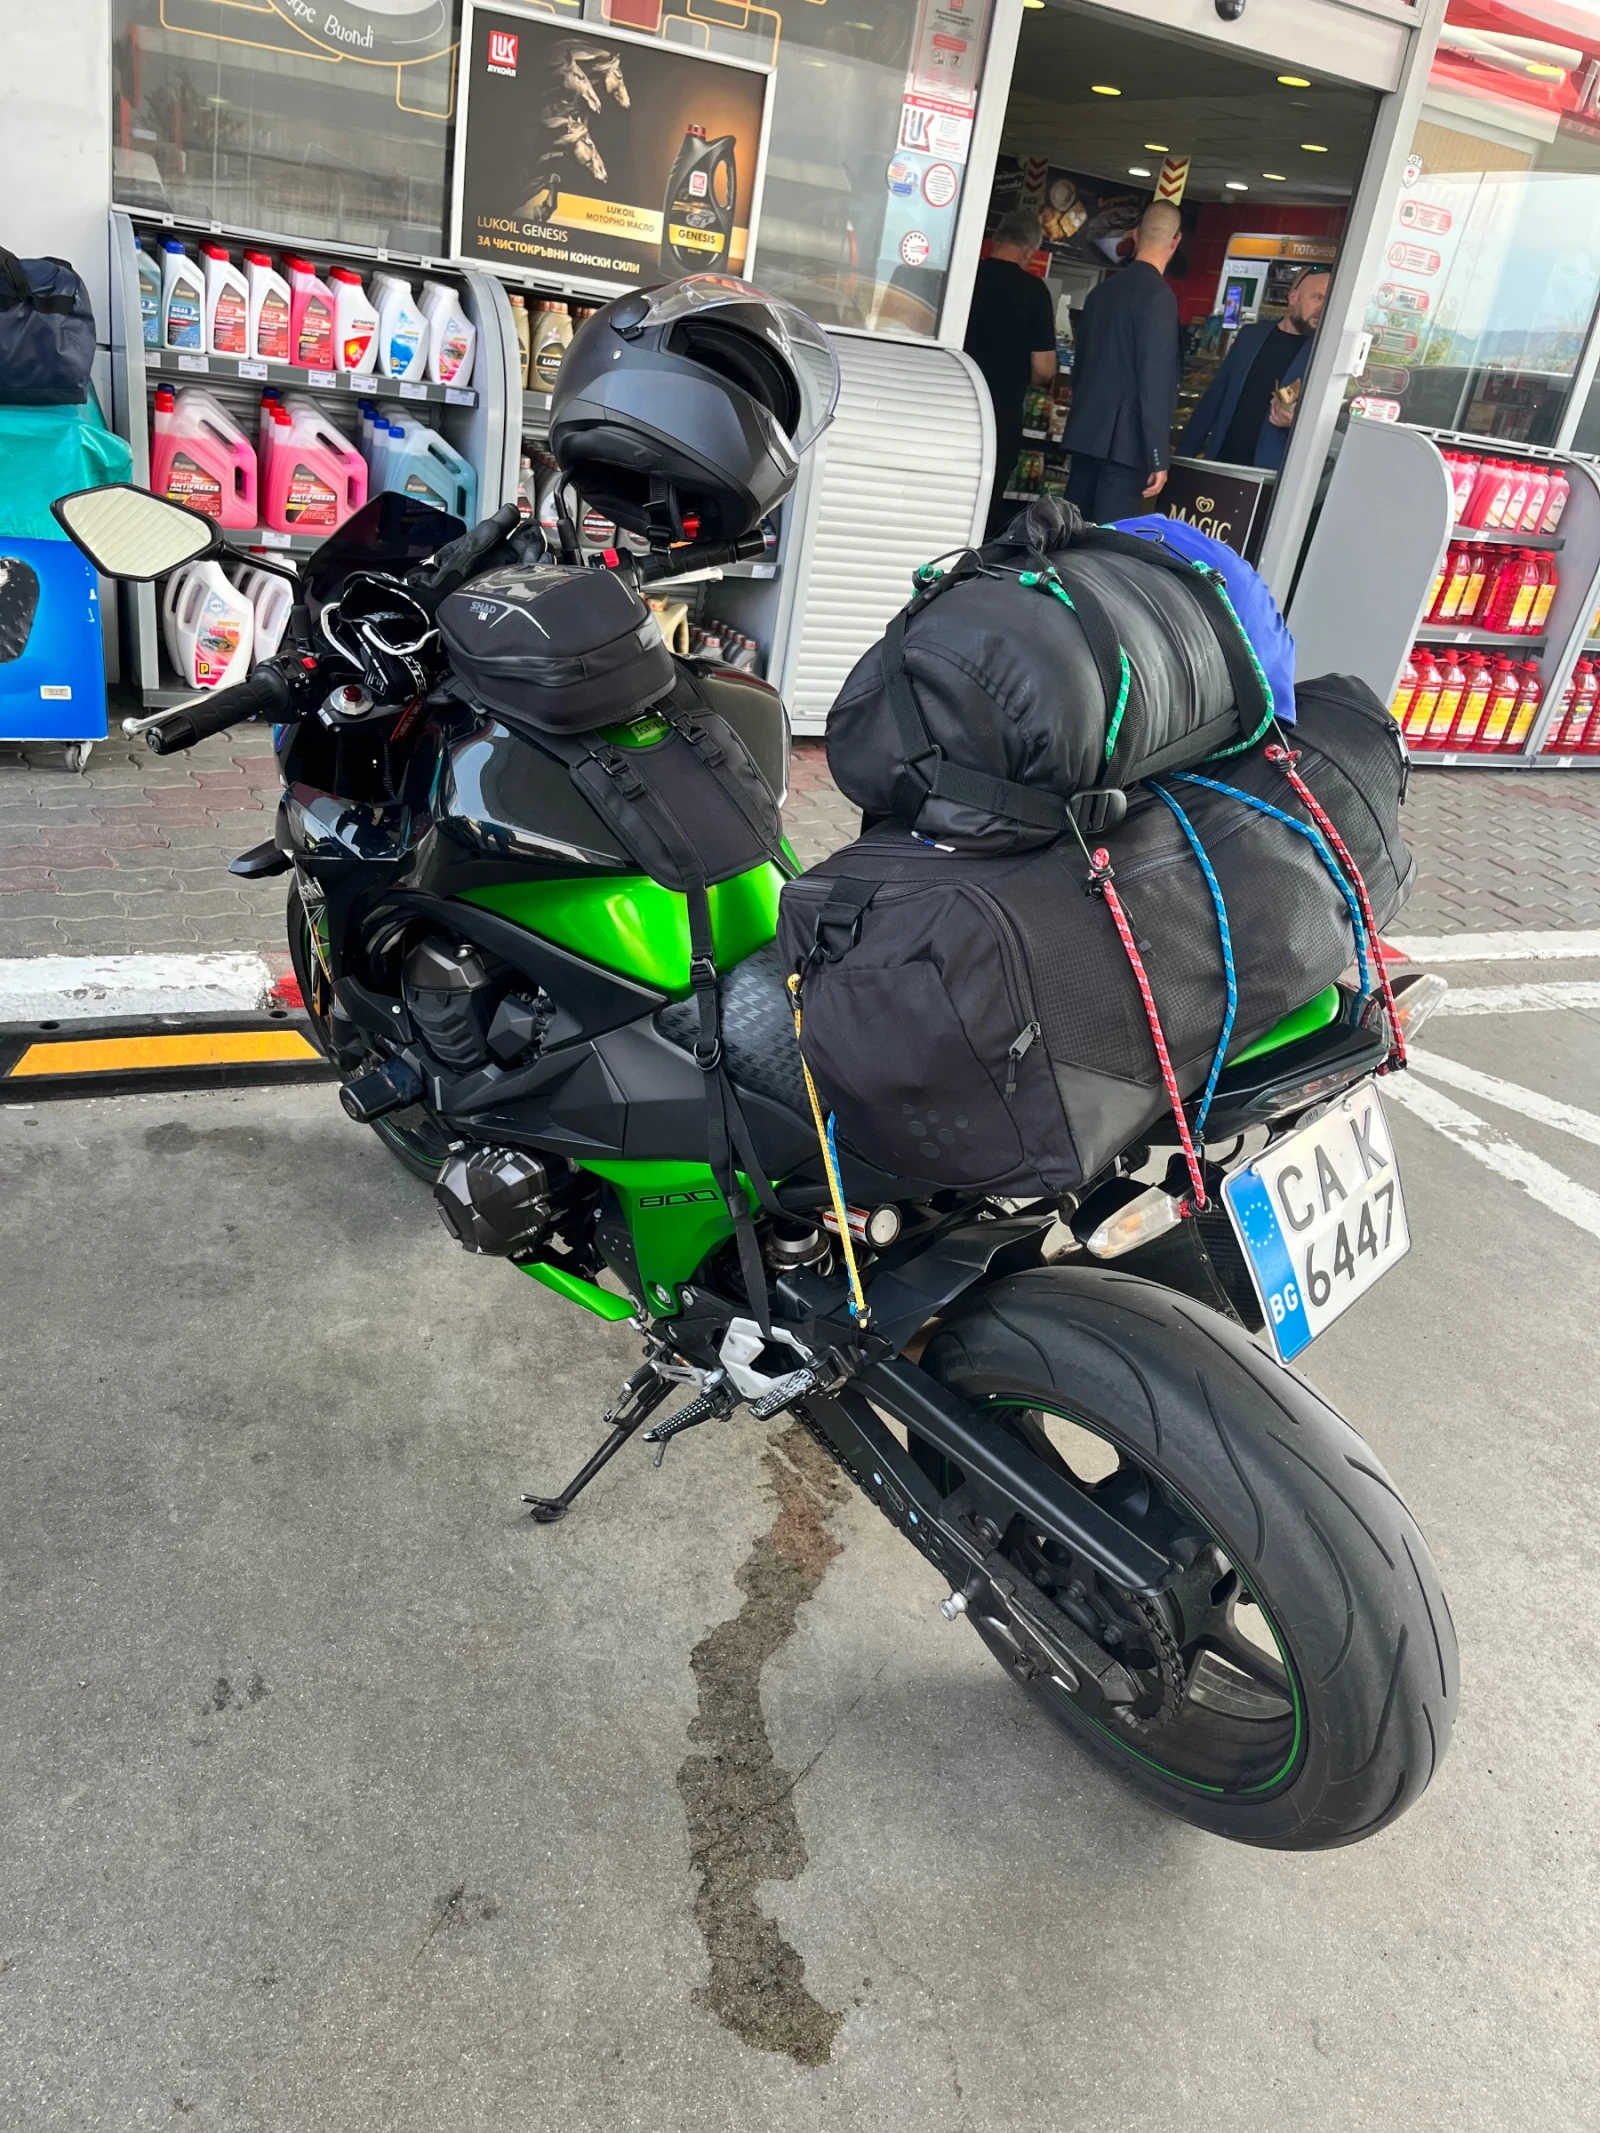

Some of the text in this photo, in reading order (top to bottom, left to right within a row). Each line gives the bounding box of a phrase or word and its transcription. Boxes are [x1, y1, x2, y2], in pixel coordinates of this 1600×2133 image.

[323, 14, 374, 49] Buondi
[586, 212, 655, 233] МОТОРНО МАСЛО
[606, 205, 635, 218] LUKOIL
[476, 214, 569, 243] LUKOIL GENESIS
[678, 229, 716, 245] GENESIS
[476, 235, 641, 274] ЗА ЧИСТОКРЪВНИ КОНСКИ СИЛИ
[170, 481, 220, 492] ANTIFREEZE
[290, 492, 336, 502] ANTIFREEZE
[1169, 503, 1232, 544] MAGIC
[470, 601, 497, 614] SHAD
[1277, 1105, 1389, 1232] CA K
[639, 1189, 720, 1208] 800
[1305, 1178, 1395, 1308] 6447
[1269, 1283, 1299, 1325] BG
